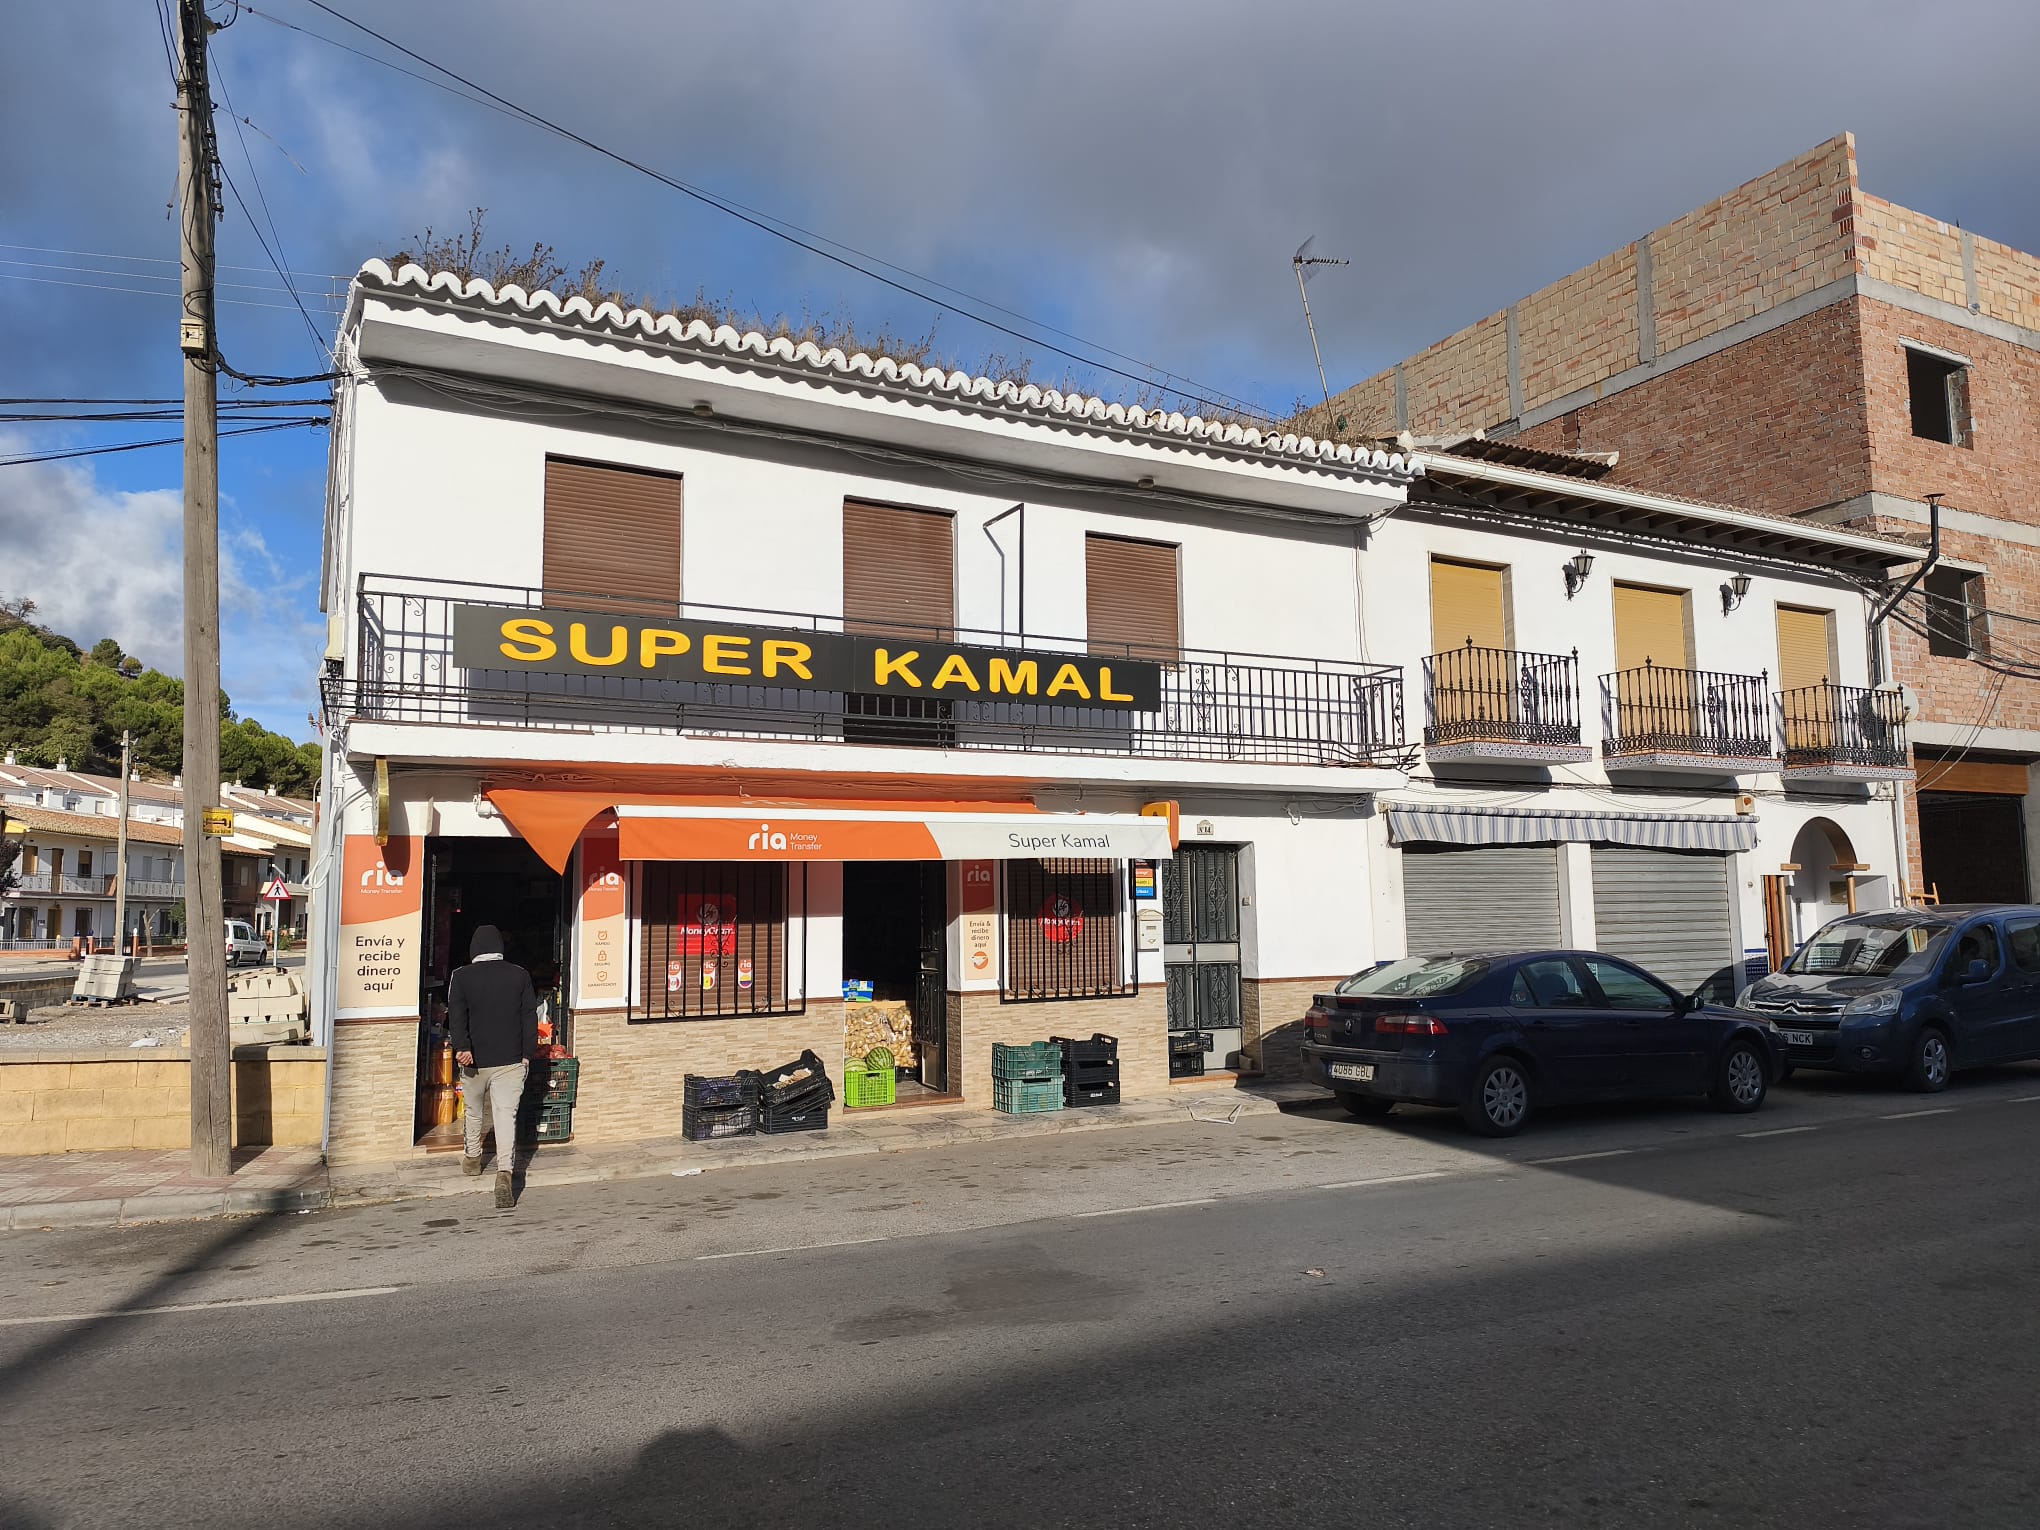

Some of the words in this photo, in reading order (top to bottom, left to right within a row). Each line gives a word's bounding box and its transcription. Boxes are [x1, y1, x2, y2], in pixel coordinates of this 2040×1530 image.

[499, 618, 814, 680] SUPER
[874, 648, 1135, 702] KAMAL
[747, 823, 787, 850] ria
[790, 832, 818, 843] Money
[1008, 833, 1057, 851] Super
[1061, 833, 1110, 848] Kamal
[790, 842, 822, 851] Transfer
[361, 861, 404, 886] ria
[589, 866, 620, 886] ria
[967, 864, 991, 882] ria
[355, 935, 393, 947] Envía
[397, 938, 405, 948] y
[974, 941, 987, 949] aquí
[358, 950, 401, 961] recibe
[357, 966, 401, 977] dinero
[363, 979, 394, 992] aquí
[1792, 1033, 1811, 1044] NCK
[1355, 1065, 1371, 1078] GBL
